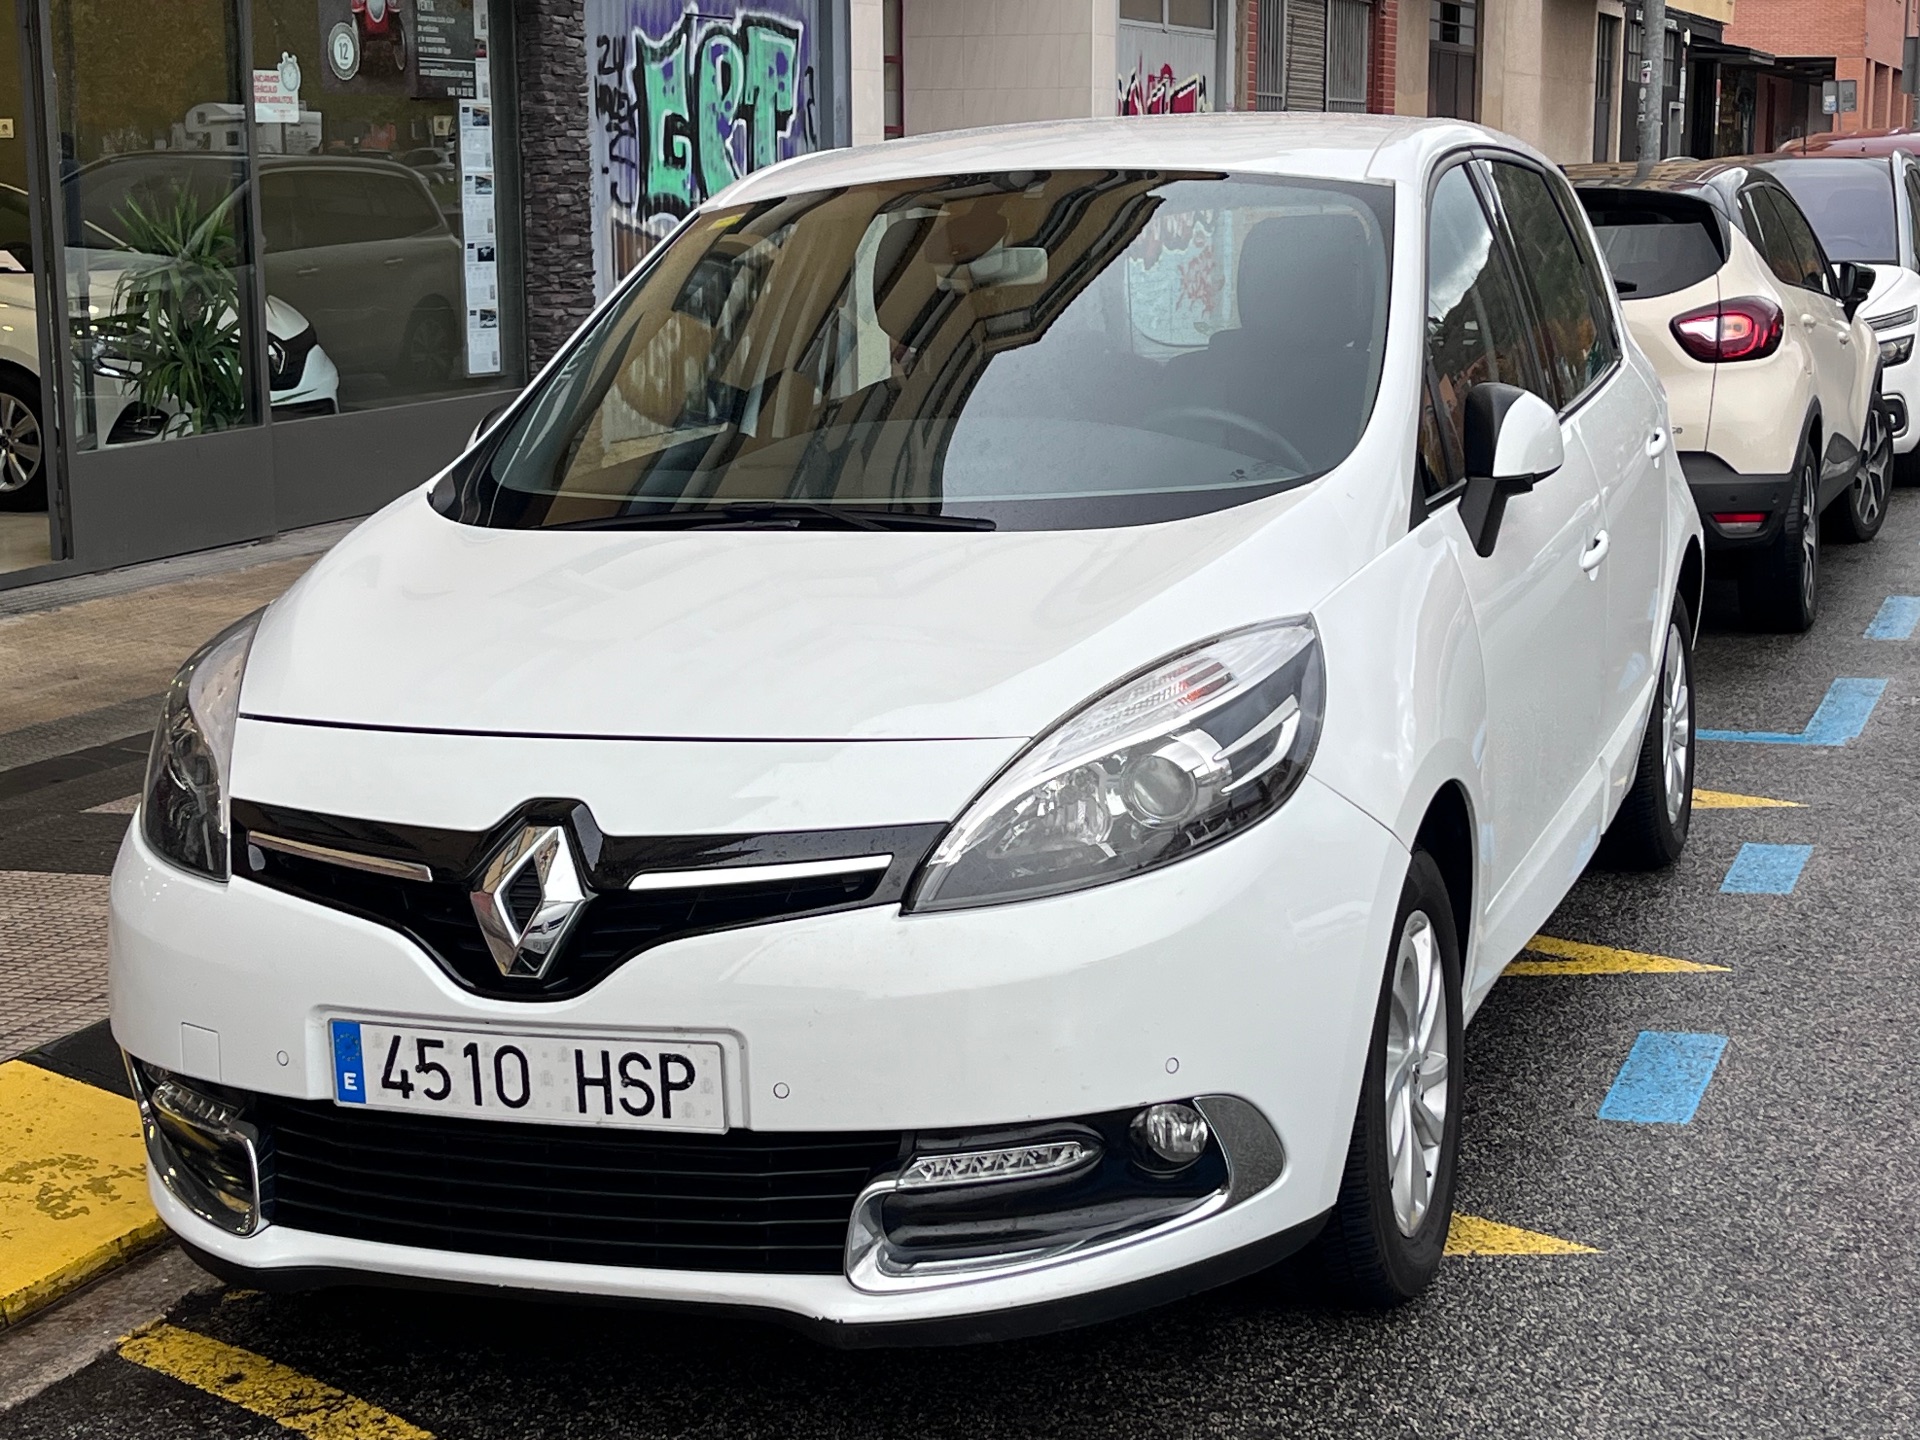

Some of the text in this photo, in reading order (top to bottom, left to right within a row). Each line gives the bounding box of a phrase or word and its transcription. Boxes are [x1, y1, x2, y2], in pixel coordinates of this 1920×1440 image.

[338, 42, 349, 60] 12
[344, 1035, 696, 1119] E 4510 HSP
